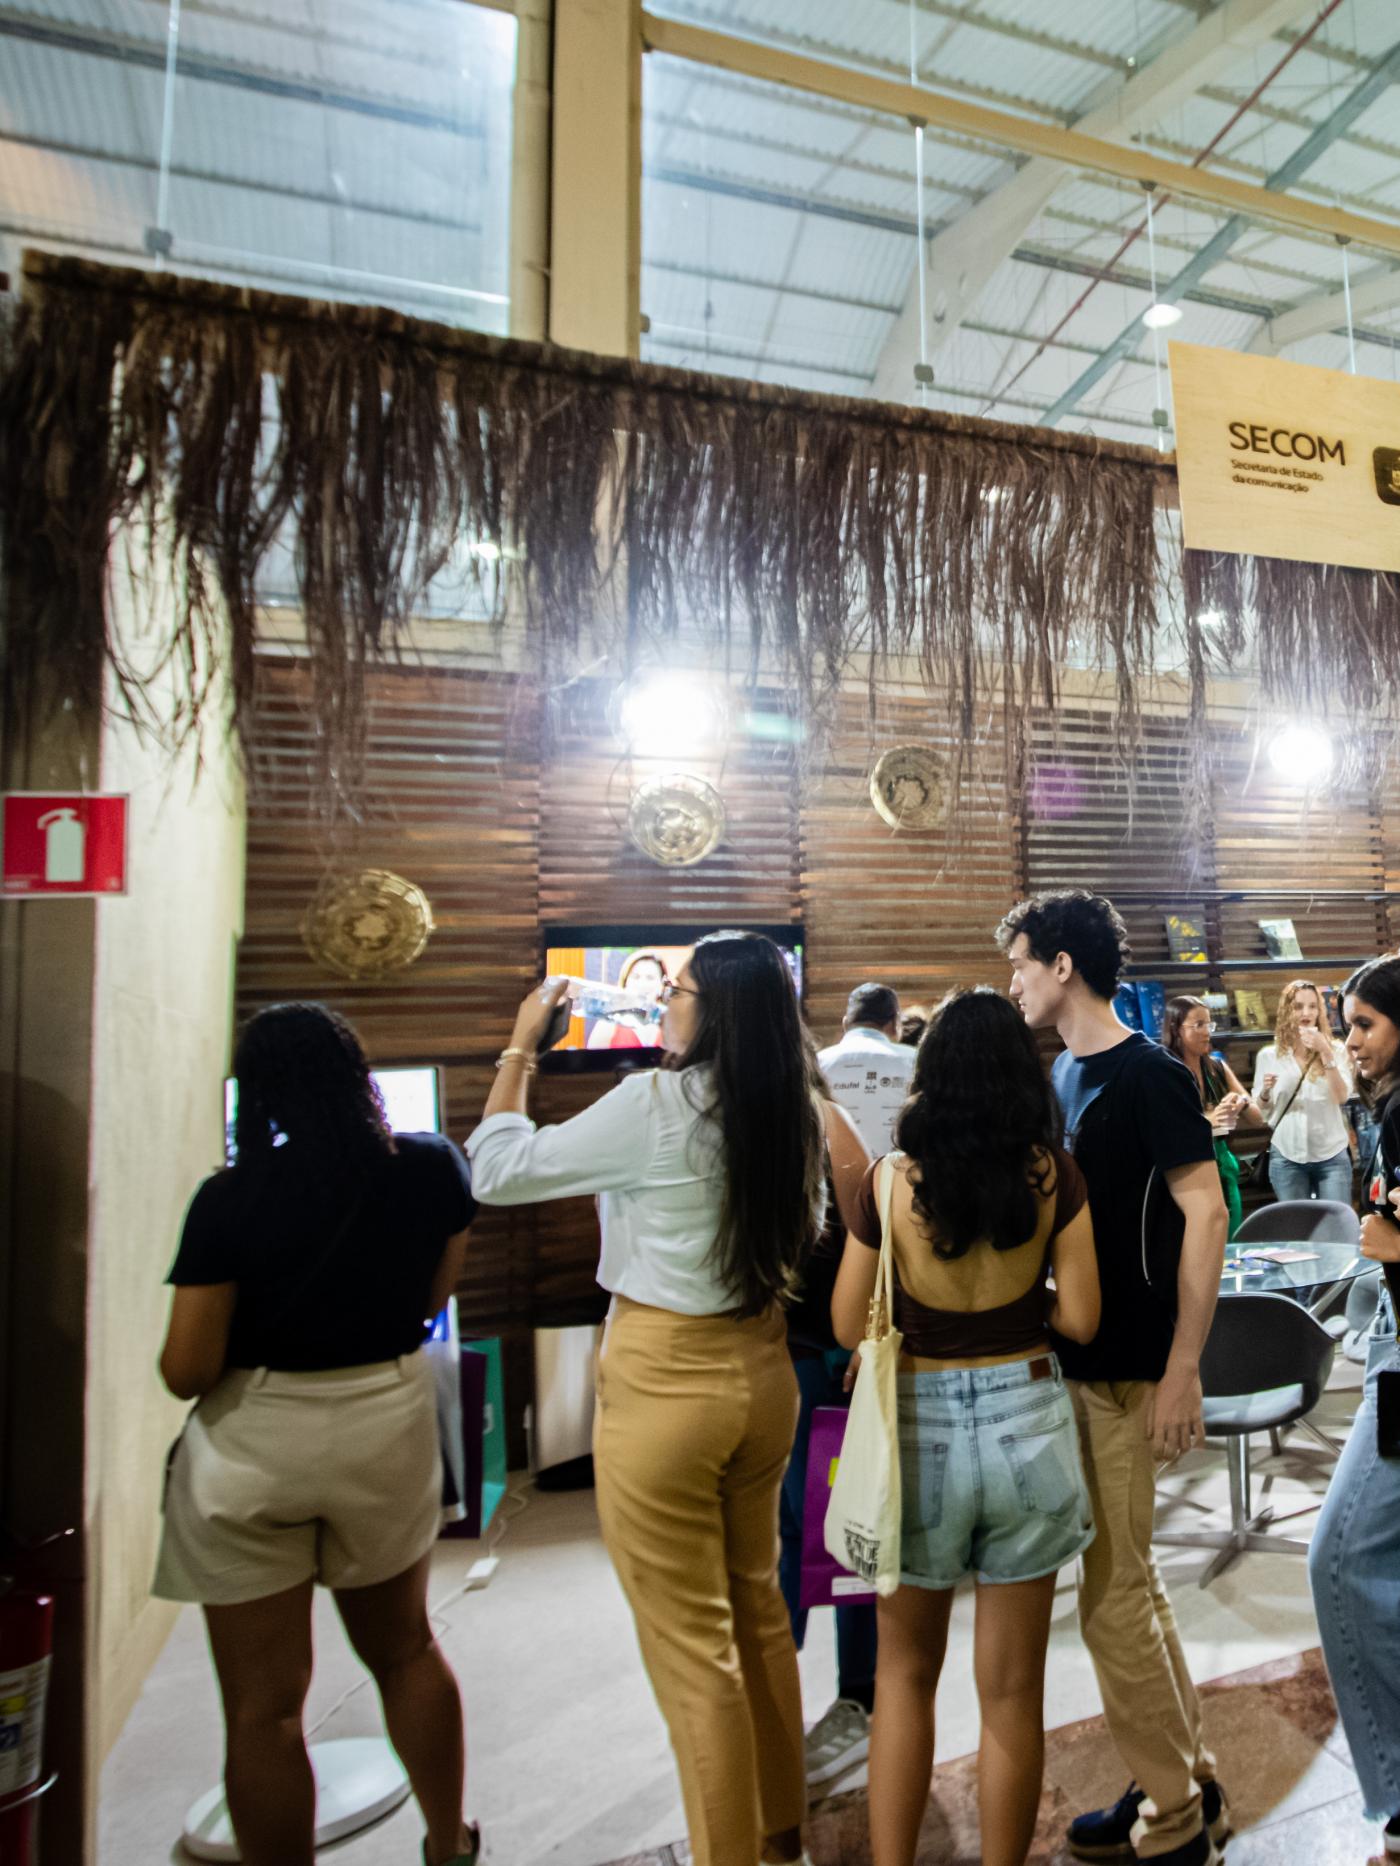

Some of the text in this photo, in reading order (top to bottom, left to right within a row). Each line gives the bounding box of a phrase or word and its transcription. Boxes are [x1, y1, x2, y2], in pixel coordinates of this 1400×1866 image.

[1228, 421, 1345, 466] SECOM
[1231, 459, 1324, 481] Secretaria de Estado
[1232, 474, 1245, 484] da
